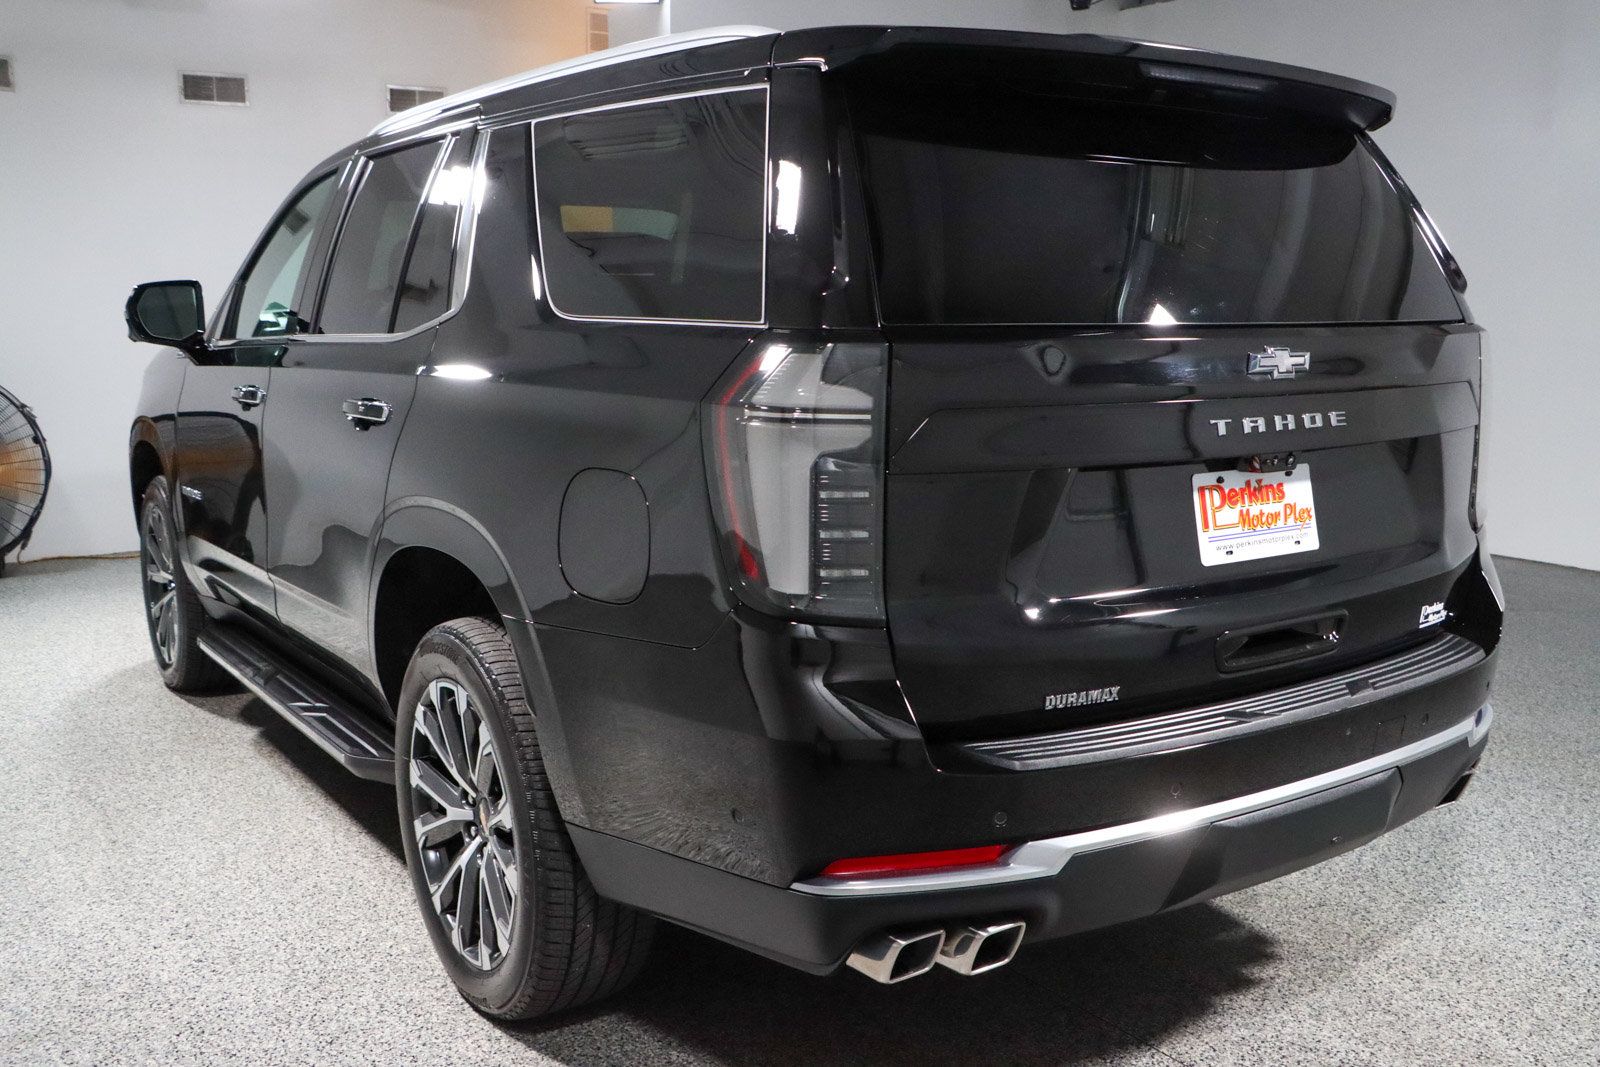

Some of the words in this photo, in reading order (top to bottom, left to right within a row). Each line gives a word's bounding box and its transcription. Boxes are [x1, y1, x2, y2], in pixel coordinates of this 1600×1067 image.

[1210, 411, 1347, 436] TAHOE
[1198, 479, 1286, 533] Perkins
[1239, 507, 1281, 532] Motor
[1283, 502, 1312, 530] Plex
[1045, 686, 1120, 710] DURAMAX
